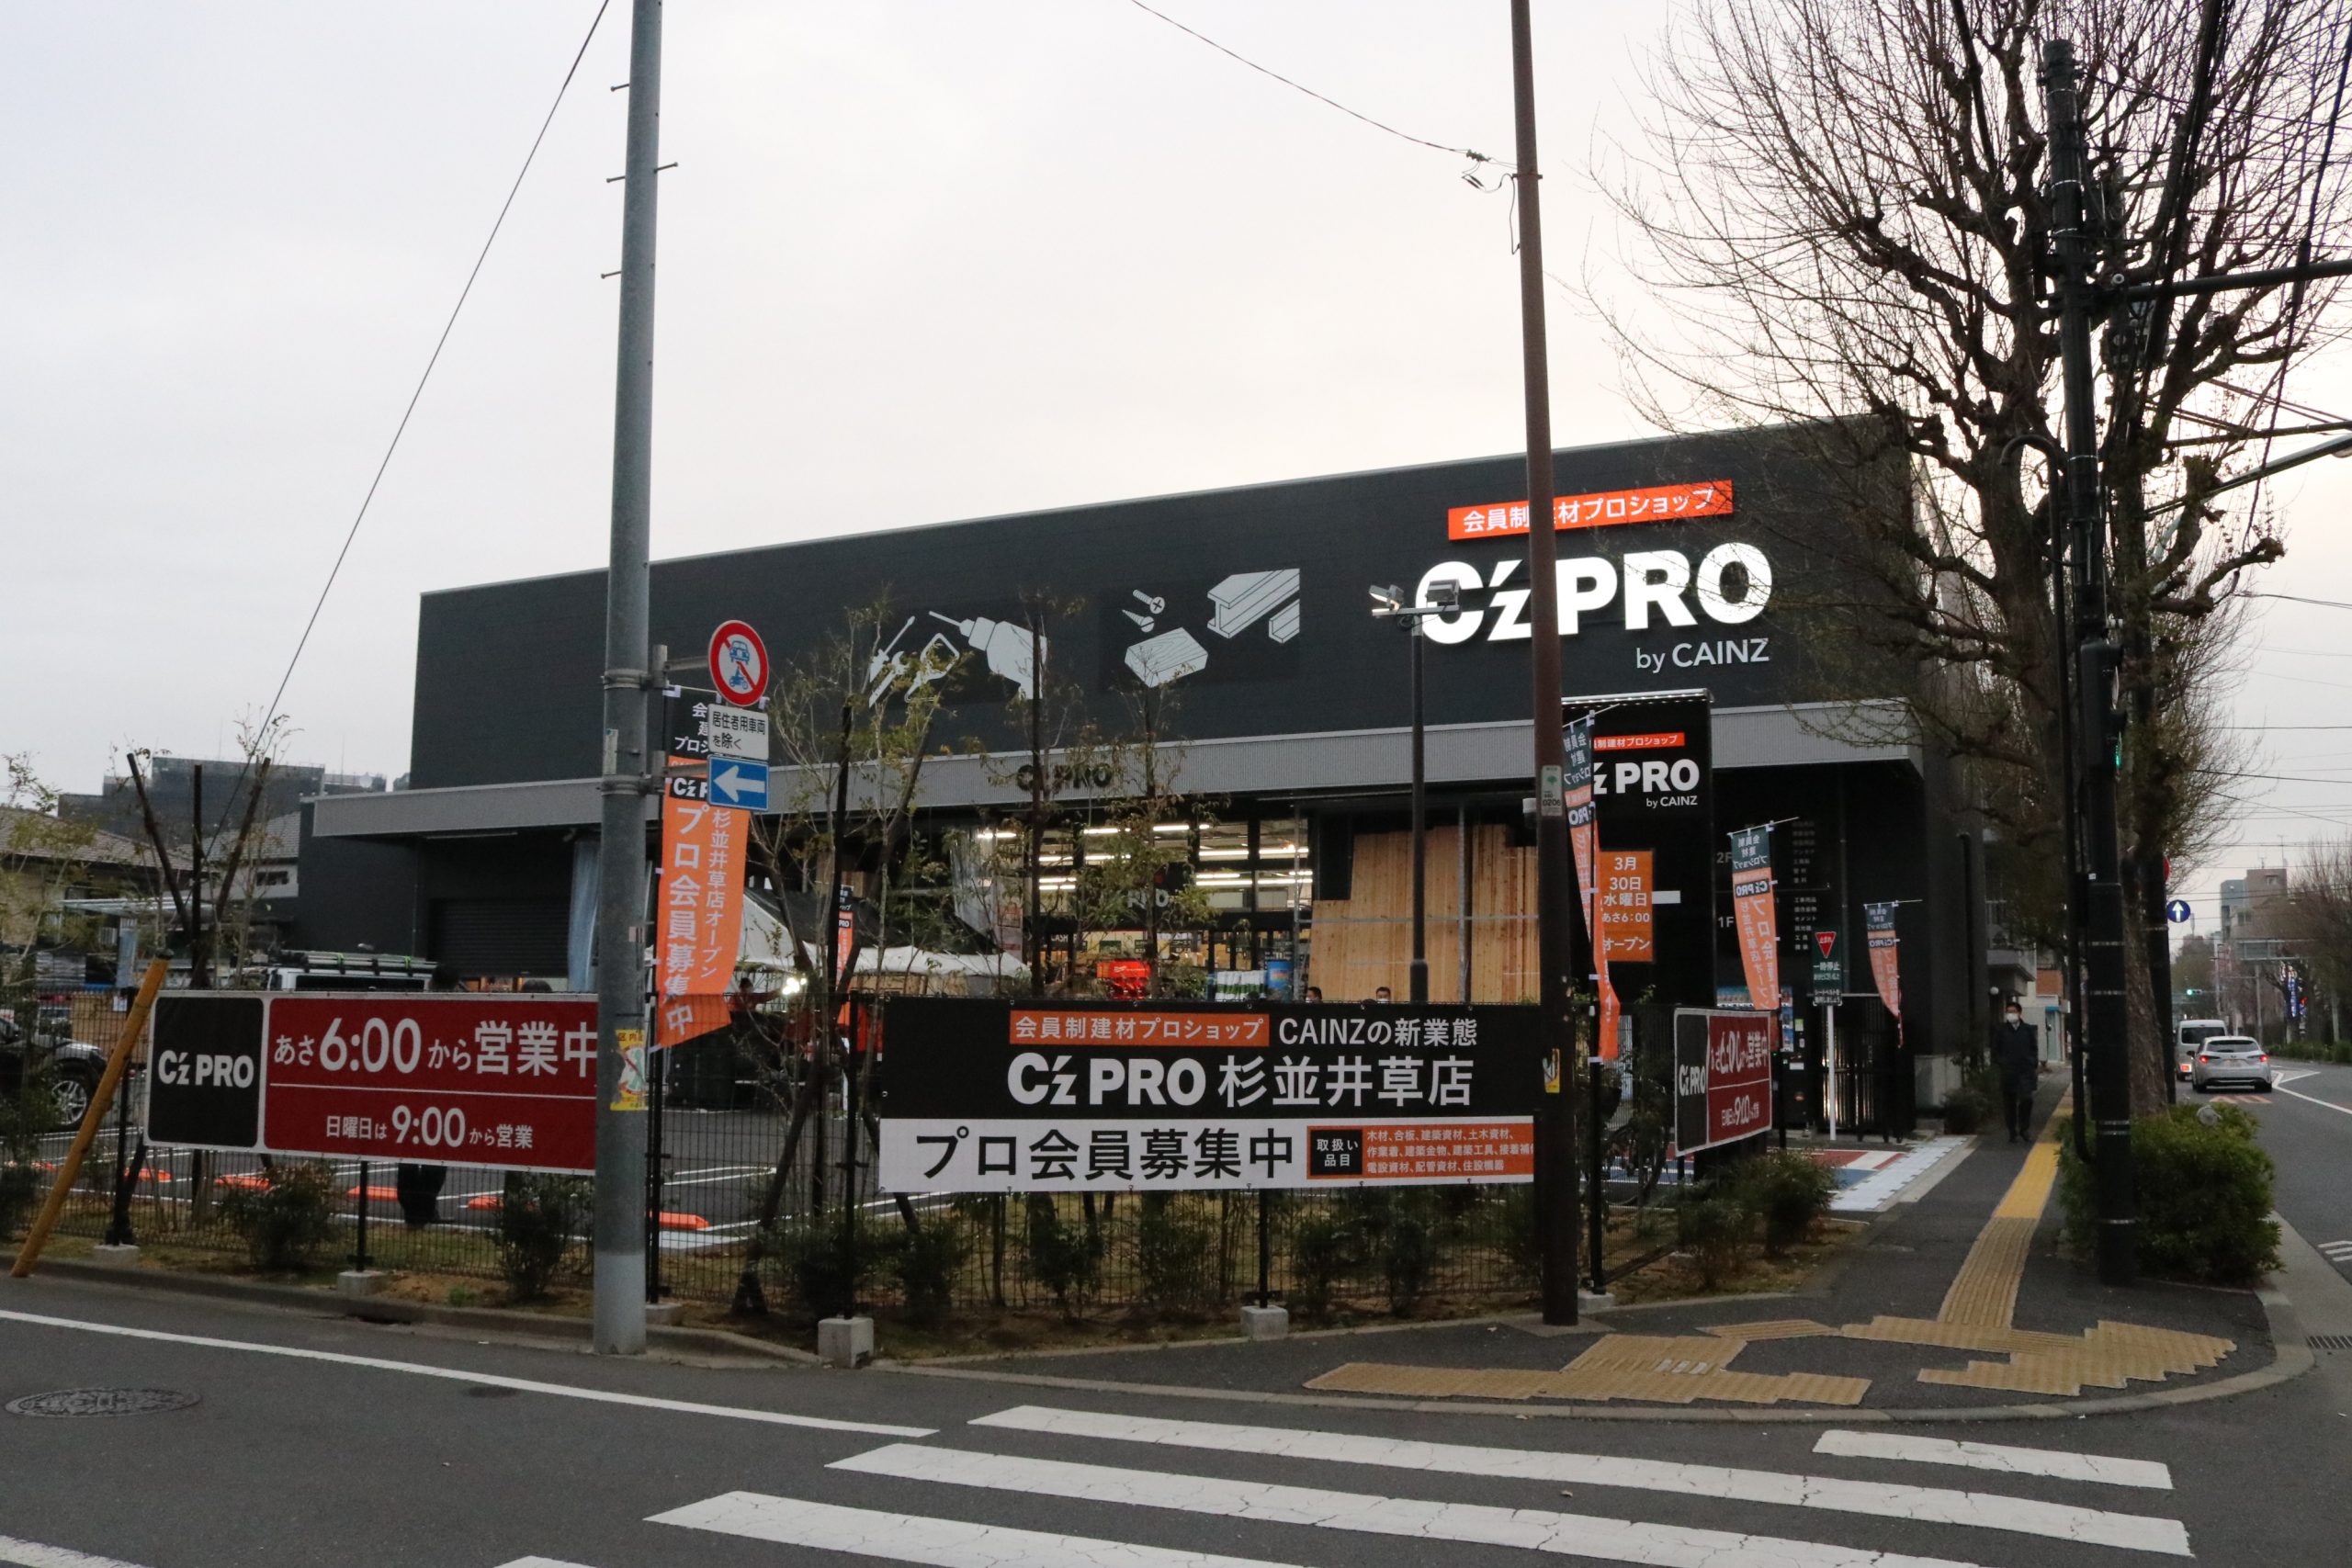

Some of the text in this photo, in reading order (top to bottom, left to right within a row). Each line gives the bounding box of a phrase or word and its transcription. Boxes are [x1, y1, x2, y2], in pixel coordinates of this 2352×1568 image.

[1464, 485, 1714, 533] 会員制材プロショップ
[1555, 542, 1772, 636] PRO
[1636, 638, 1770, 673] by CAINZ
[713, 711, 766, 735] 居住者用車両
[713, 732, 741, 750] を除く
[1594, 735, 1678, 749] 制建材プロショップ
[1615, 759, 1700, 795] PRO
[1646, 795, 1698, 808] by CAINZ
[1614, 856, 1636, 871] 3月
[700, 809, 731, 978] 杉並井草店オープン
[1610, 876, 1641, 891] 30日
[1604, 893, 1647, 907] 水曜日
[1602, 912, 1650, 923] あさ6:00
[1719, 917, 1734, 928] 1F
[1603, 936, 1650, 951] オープン
[1015, 1018, 1477, 1046] 会員制建材プロショップ CAINZの新業態
[196, 1055, 254, 1089] PRO
[1090, 1058, 1205, 1104] PRO
[1219, 1055, 1475, 1106] 杉並井草店
[1690, 1066, 1705, 1095] PRO
[915, 1125, 1294, 1181] プロ会員募集中
[1317, 1138, 1359, 1151] 取扱い
[1325, 1154, 1351, 1167] 品目
